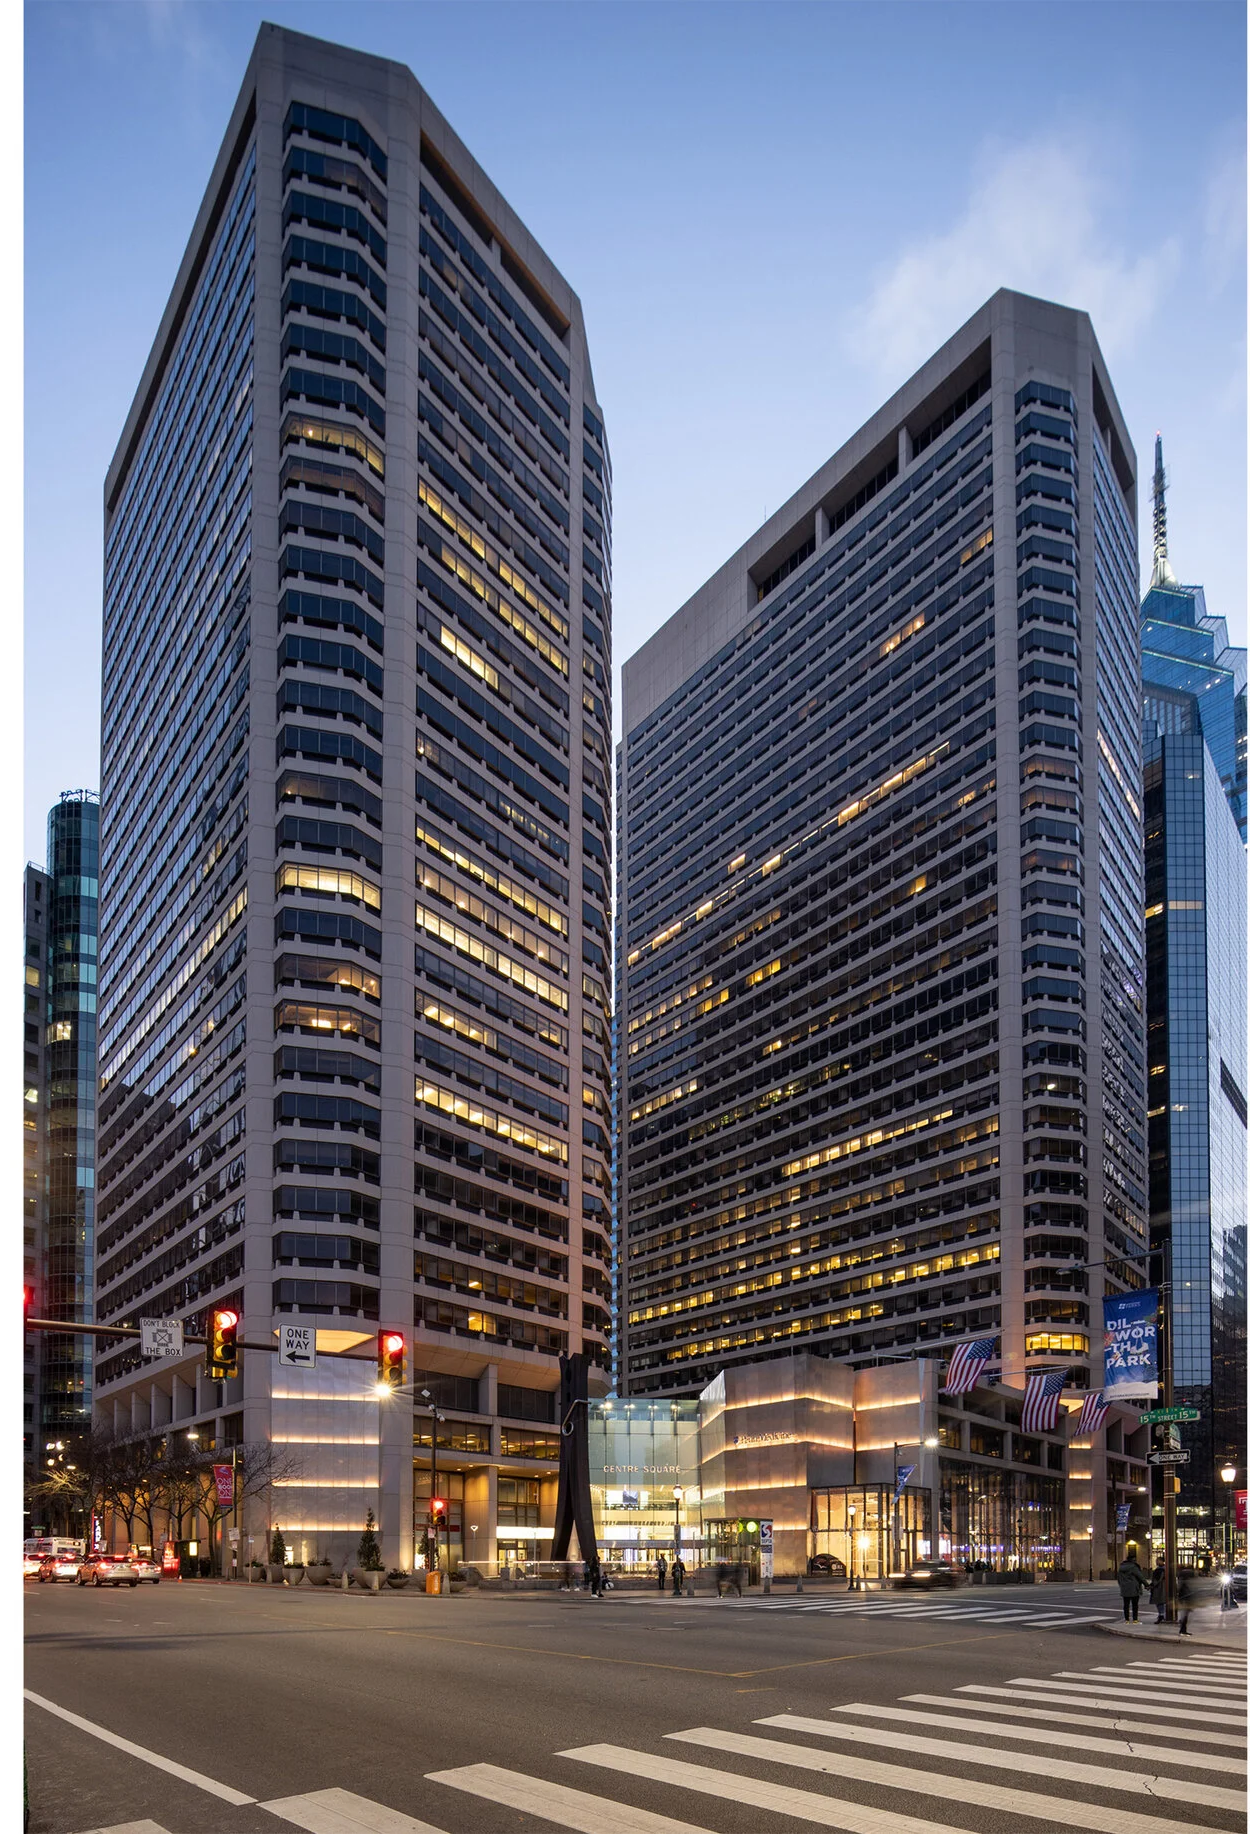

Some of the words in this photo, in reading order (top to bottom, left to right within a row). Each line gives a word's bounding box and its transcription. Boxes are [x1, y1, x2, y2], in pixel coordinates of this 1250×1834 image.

[143, 1319, 159, 1327] DON'T
[286, 1328, 309, 1340] ONE
[1115, 1326, 1155, 1341] WOR
[285, 1339, 310, 1350] WAY
[145, 1347, 160, 1355] THE
[165, 1348, 181, 1356] BOX
[1106, 1353, 1151, 1369] PARK
[603, 1465, 639, 1473] CENTRE
[643, 1465, 681, 1473] SQUARE
